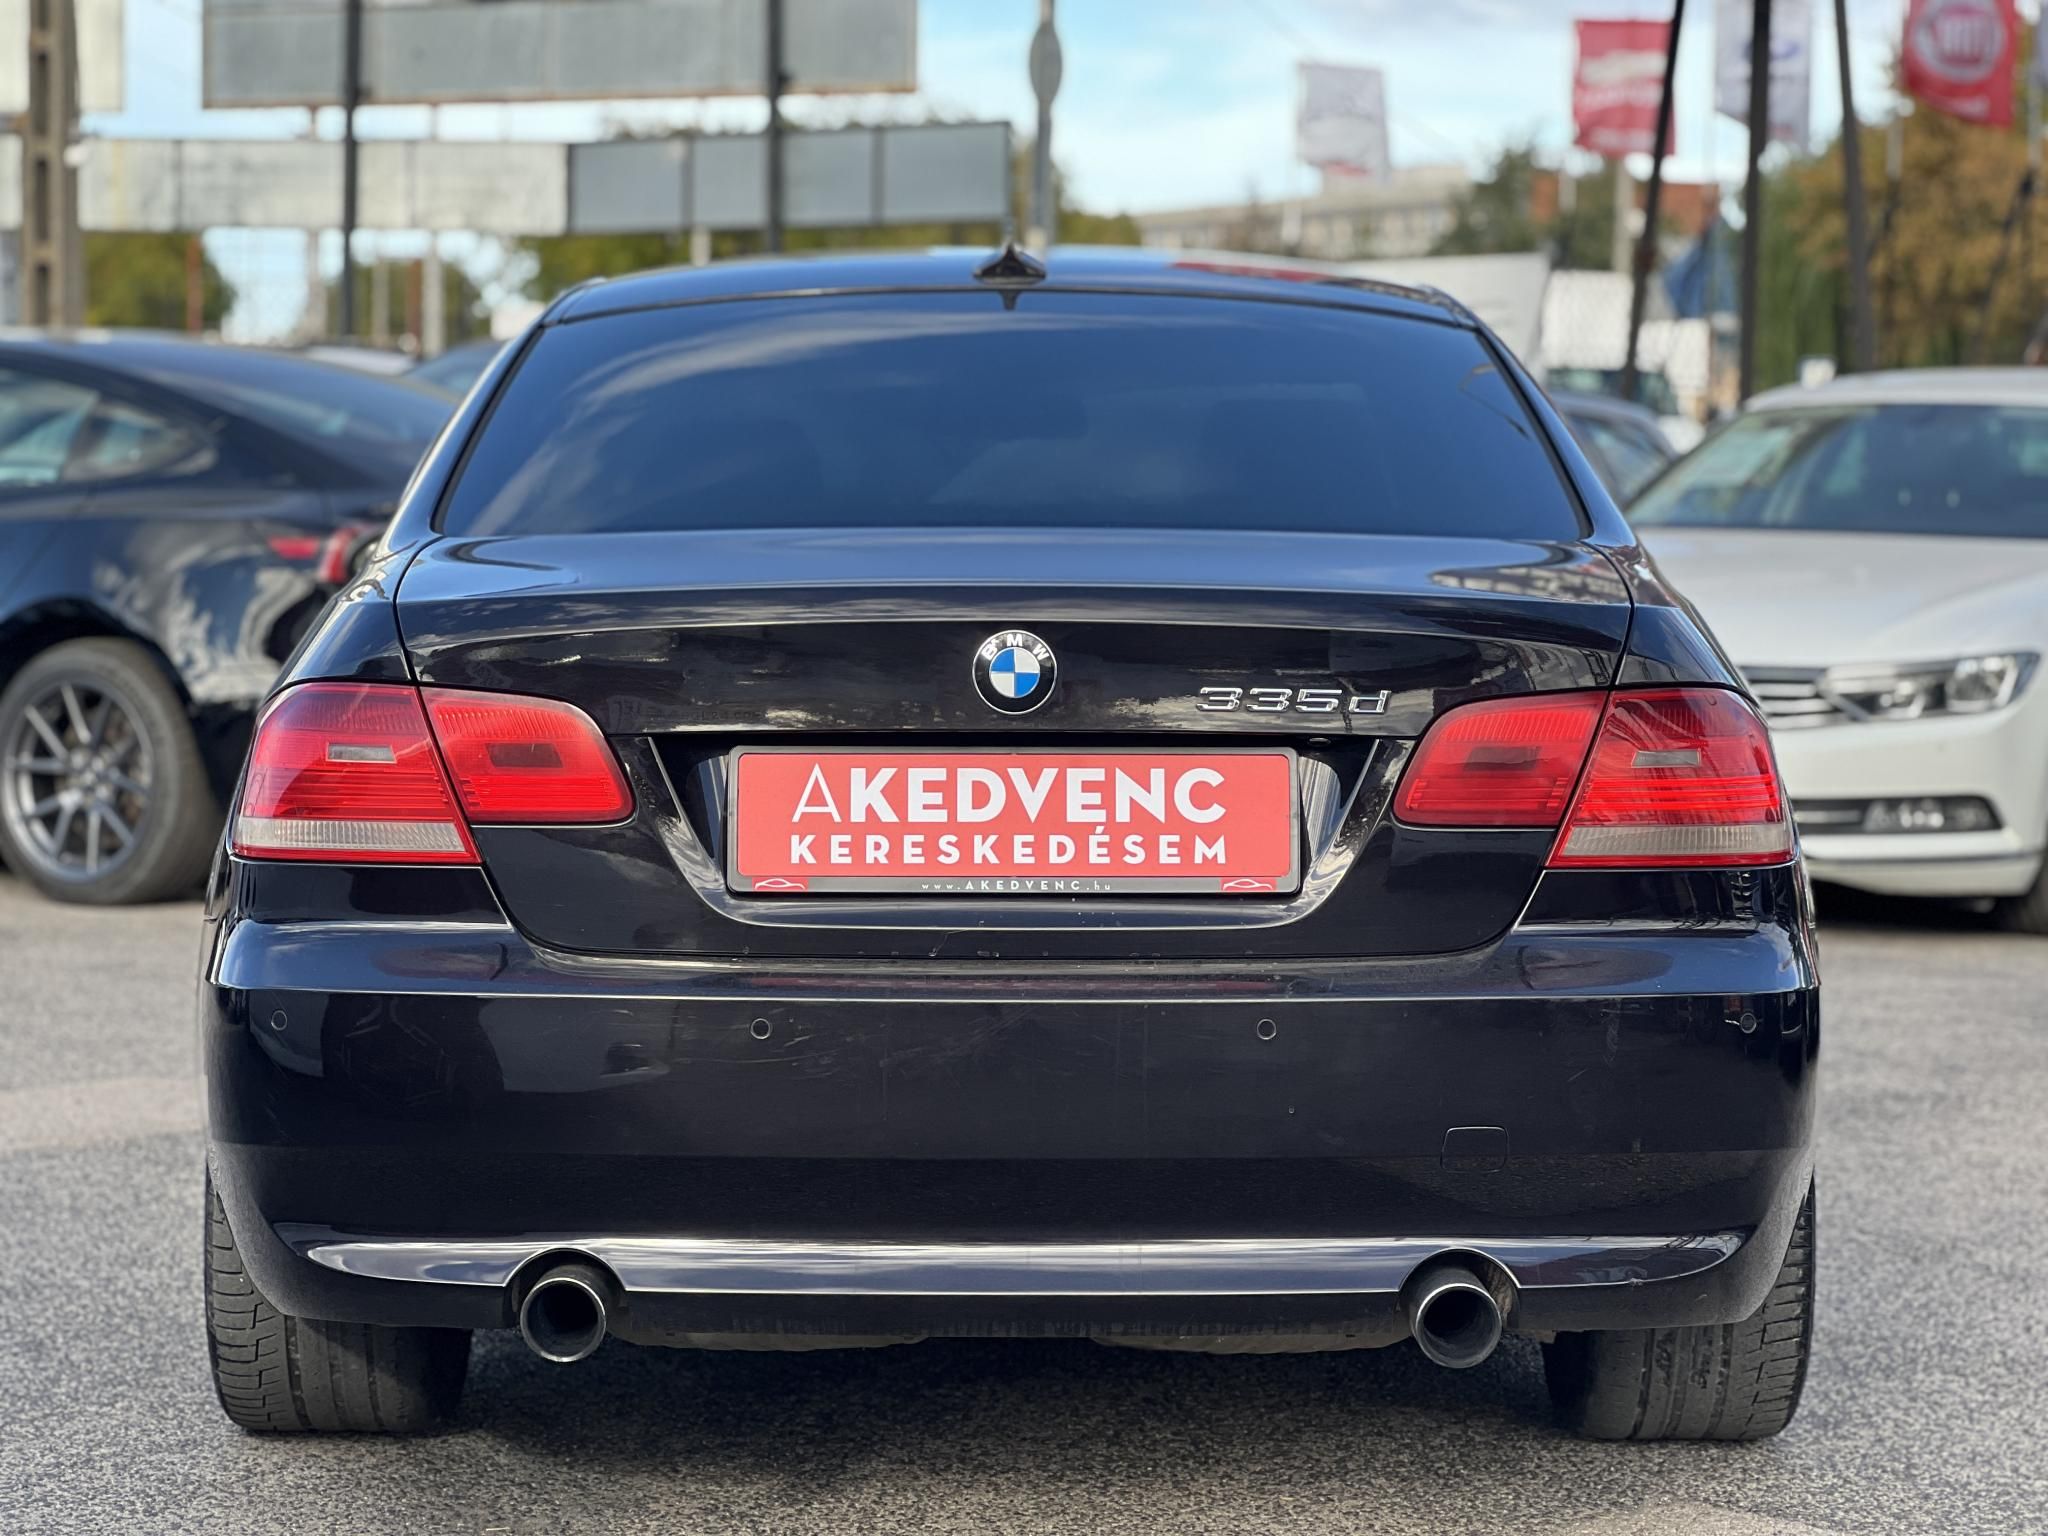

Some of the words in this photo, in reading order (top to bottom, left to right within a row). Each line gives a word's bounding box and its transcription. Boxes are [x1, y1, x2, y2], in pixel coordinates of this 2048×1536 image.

[981, 633, 1050, 661] BMW
[1196, 687, 1392, 715] 335d
[791, 763, 1227, 824] AKEDVENC
[790, 826, 1226, 864] KERESKEDÉSEM
[921, 879, 1111, 891] www.AKEDVENC.hu
